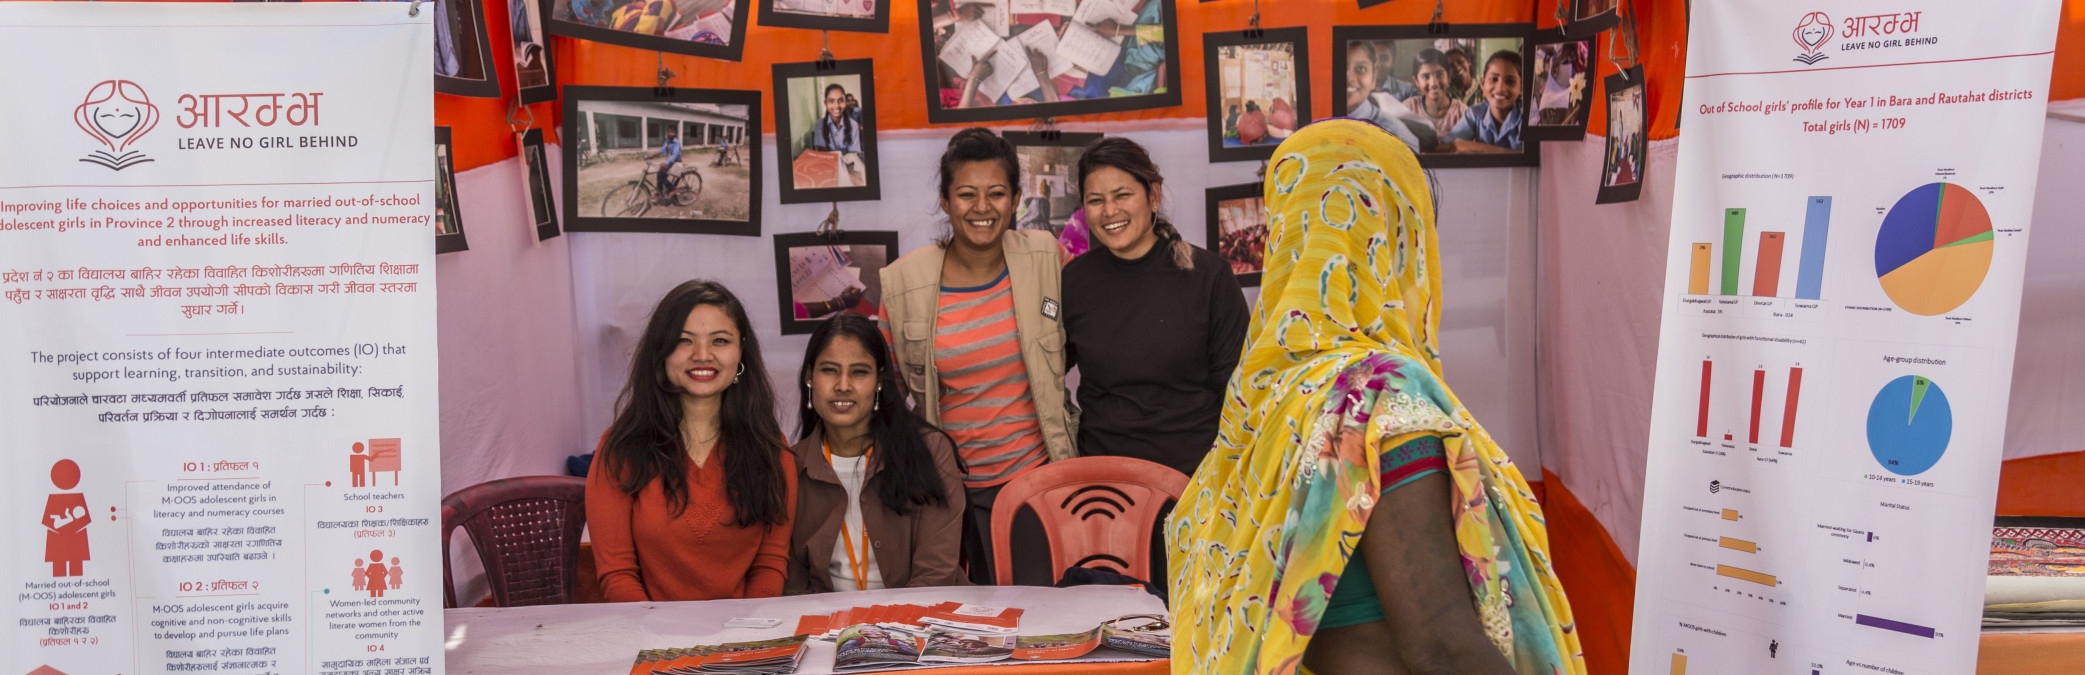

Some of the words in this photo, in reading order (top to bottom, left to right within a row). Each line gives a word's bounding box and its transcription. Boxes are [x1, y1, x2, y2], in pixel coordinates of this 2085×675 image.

[1842, 12, 1922, 38] आरम्भ
[1842, 42, 1866, 51] LEAVE
[1868, 41, 1881, 49] NO
[1883, 40, 1902, 48] GIRL
[1905, 36, 1938, 46] BEHIND
[1700, 104, 1715, 115] Out
[1716, 101, 1726, 113] of
[1728, 101, 1762, 112] School
[1791, 98, 1823, 113] profile
[1826, 98, 1841, 109] for
[1844, 98, 1867, 108] Year
[1877, 97, 1886, 107] in
[1889, 95, 1912, 106] Bara
[1915, 92, 1936, 105] and
[1938, 91, 1986, 104] Rautahat
[1988, 89, 2032, 101] districts
[176, 93, 324, 128] आरम्भ
[1803, 120, 1827, 132] Total
[1829, 120, 1851, 135] girls
[1854, 119, 1870, 134] (N)
[1882, 118, 1906, 129] 1709
[179, 137, 224, 150] LEAVE
[230, 137, 253, 149] NO
[259, 136, 294, 148] GIRL
[300, 136, 358, 148] BEHIND
[1, 200, 62, 215] Improving
[66, 198, 87, 210] life
[91, 198, 141, 210] choices
[145, 198, 168, 210] and
[172, 199, 258, 213] opportunities
[261, 196, 280, 208] for
[284, 195, 331, 208] married
[335, 194, 420, 207] out-of-school
[58, 216, 86, 232] girls
[90, 218, 102, 228] in
[106, 217, 163, 228] Province
[166, 216, 175, 228] 2
[178, 216, 229, 231] through
[232, 214, 292, 227] increased
[296, 214, 342, 228] literacy
[345, 212, 368, 224] and
[372, 215, 431, 226] numeracy
[138, 235, 162, 247] and
[165, 234, 227, 246] enhanced
[231, 233, 251, 245] life
[255, 233, 288, 245] skills.
[2, 269, 30, 284] प्रदेश
[47, 271, 54, 282] २
[58, 270, 74, 280] का
[78, 267, 126, 280] विद्यालय
[130, 266, 163, 280] बाहिर
[166, 266, 200, 279] रहेका
[204, 265, 248, 278] विवाहित
[379, 262, 419, 275] शिक्षामा
[30, 351, 54, 363] The
[57, 351, 98, 366] project
[102, 350, 154, 360] consists
[157, 347, 171, 360] of
[175, 347, 202, 360] four
[206, 346, 285, 359] intermediate
[289, 347, 350, 357] outcomes
[354, 343, 379, 359] (IO)
[382, 343, 406, 355] that
[1883, 354, 1912, 364] Age-group
[1913, 357, 1946, 366] distribution
[73, 370, 120, 383] support
[124, 367, 181, 382] learning,
[185, 367, 247, 378] transition,
[251, 364, 274, 376] and
[278, 362, 362, 377] sustainability:
[183, 462, 197, 472] IO
[213, 460, 249, 472] प्रतिफल
[167, 483, 210, 493] Improved
[212, 482, 260, 491] attendance
[262, 480, 271, 490] of
[199, 495, 247, 504] adolescent
[249, 494, 267, 505] girls
[344, 493, 371, 501] School
[372, 492, 405, 500] teachers
[153, 510, 186, 520] literacy
[188, 508, 205, 517] and
[25, 581, 56, 589] Married
[58, 579, 110, 588] out-of-school
[179, 582, 193, 592] IO
[196, 581, 203, 591] 2
[211, 579, 248, 591] प्रतिफल
[252, 581, 259, 590] २
[58, 591, 99, 599] adolescent
[100, 590, 116, 600] girls
[50, 603, 60, 611] IO
[67, 602, 81, 610] and
[186, 604, 234, 612] adolescent
[236, 602, 255, 613] girls
[257, 602, 289, 611] acquire
[326, 610, 362, 618] networks
[363, 609, 378, 617] and
[151, 619, 187, 629] cognitive
[189, 616, 205, 626] and
[207, 616, 269, 626] non-cognitive
[271, 614, 292, 622] skills
[389, 619, 408, 627] from
[164, 630, 197, 640] develop
[198, 629, 215, 638] and
[217, 631, 248, 640] pursue
[250, 627, 264, 636] life
[266, 627, 289, 638] plans
